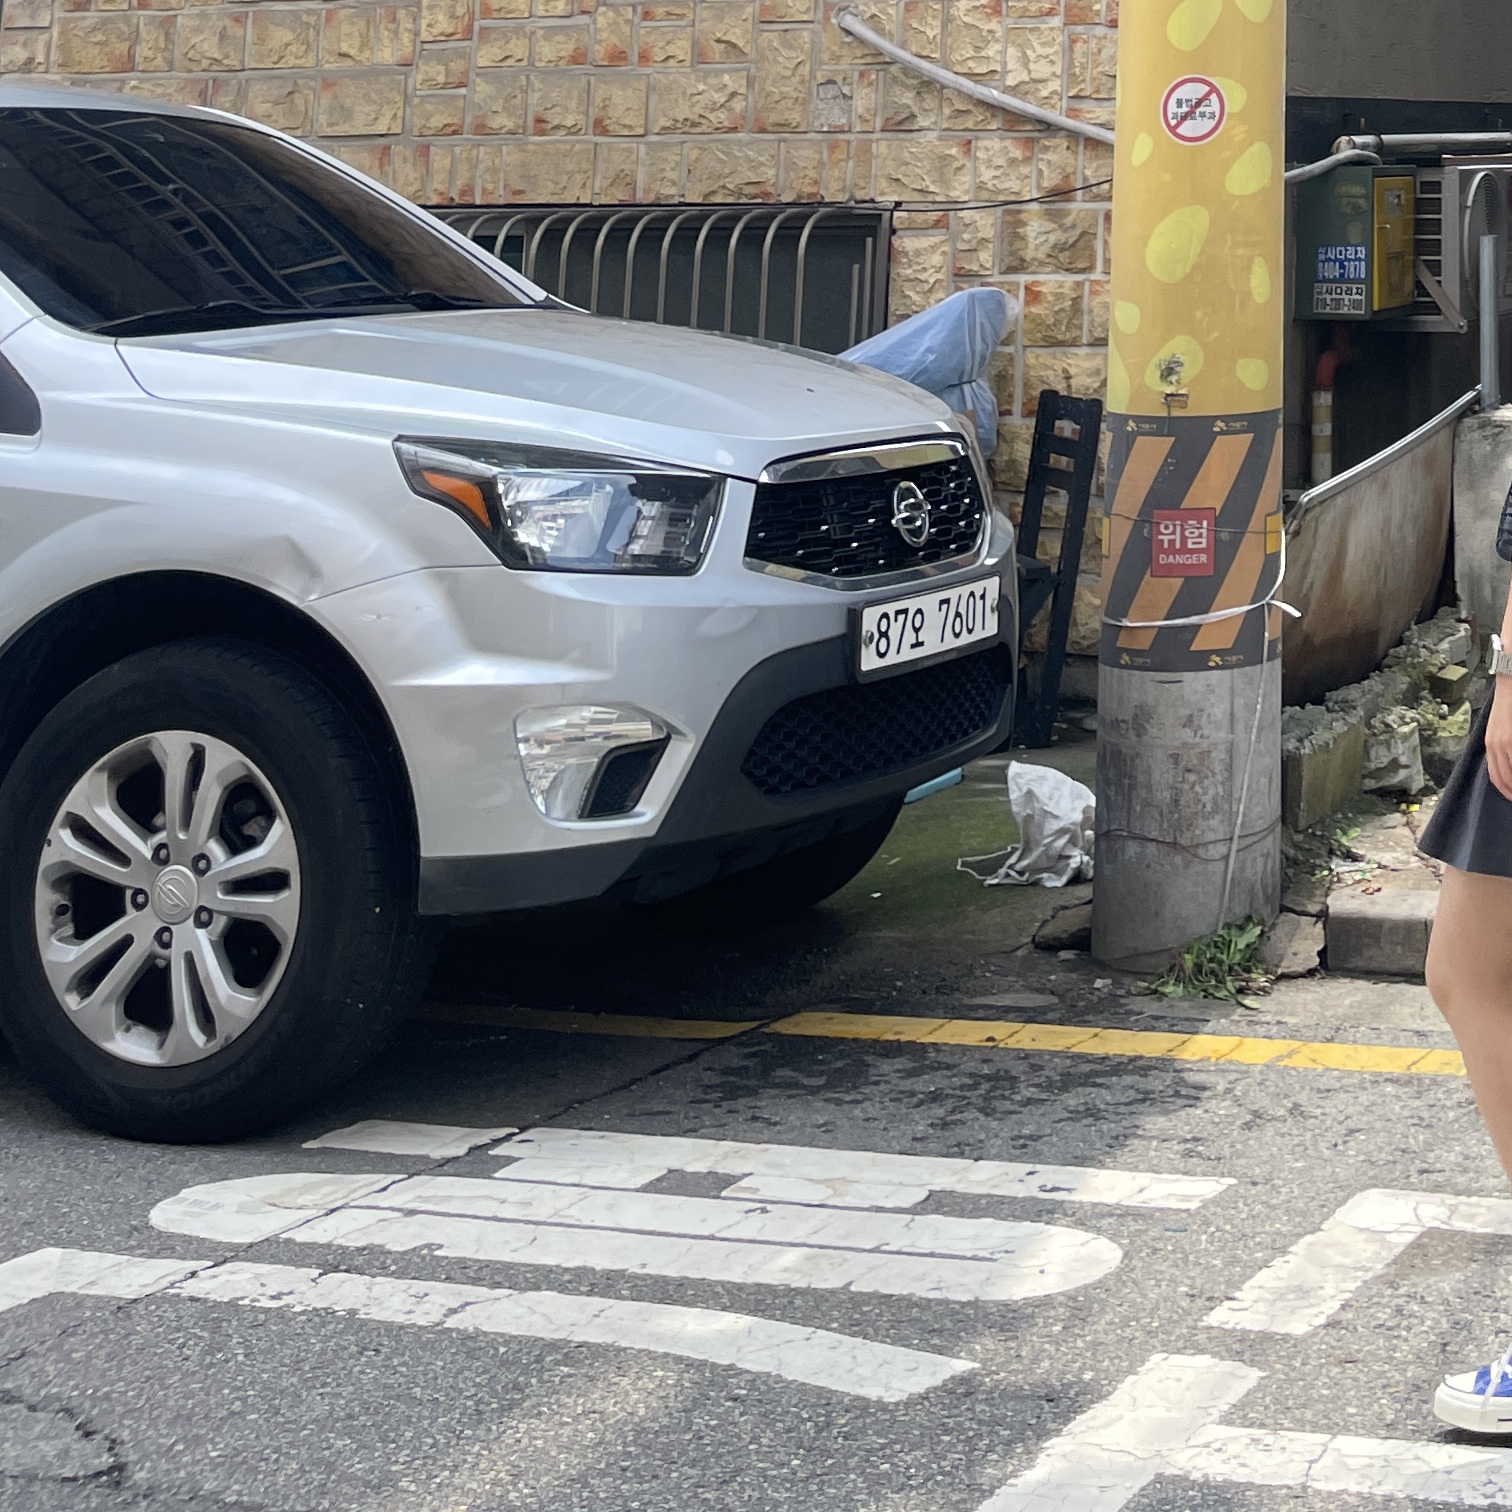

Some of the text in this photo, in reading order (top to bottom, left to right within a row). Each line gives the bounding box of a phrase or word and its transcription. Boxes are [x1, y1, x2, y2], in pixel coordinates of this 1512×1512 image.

[1157, 519, 1208, 550] 위험
[1158, 553, 1208, 566] DANGER
[875, 586, 988, 659] 87오 7601
